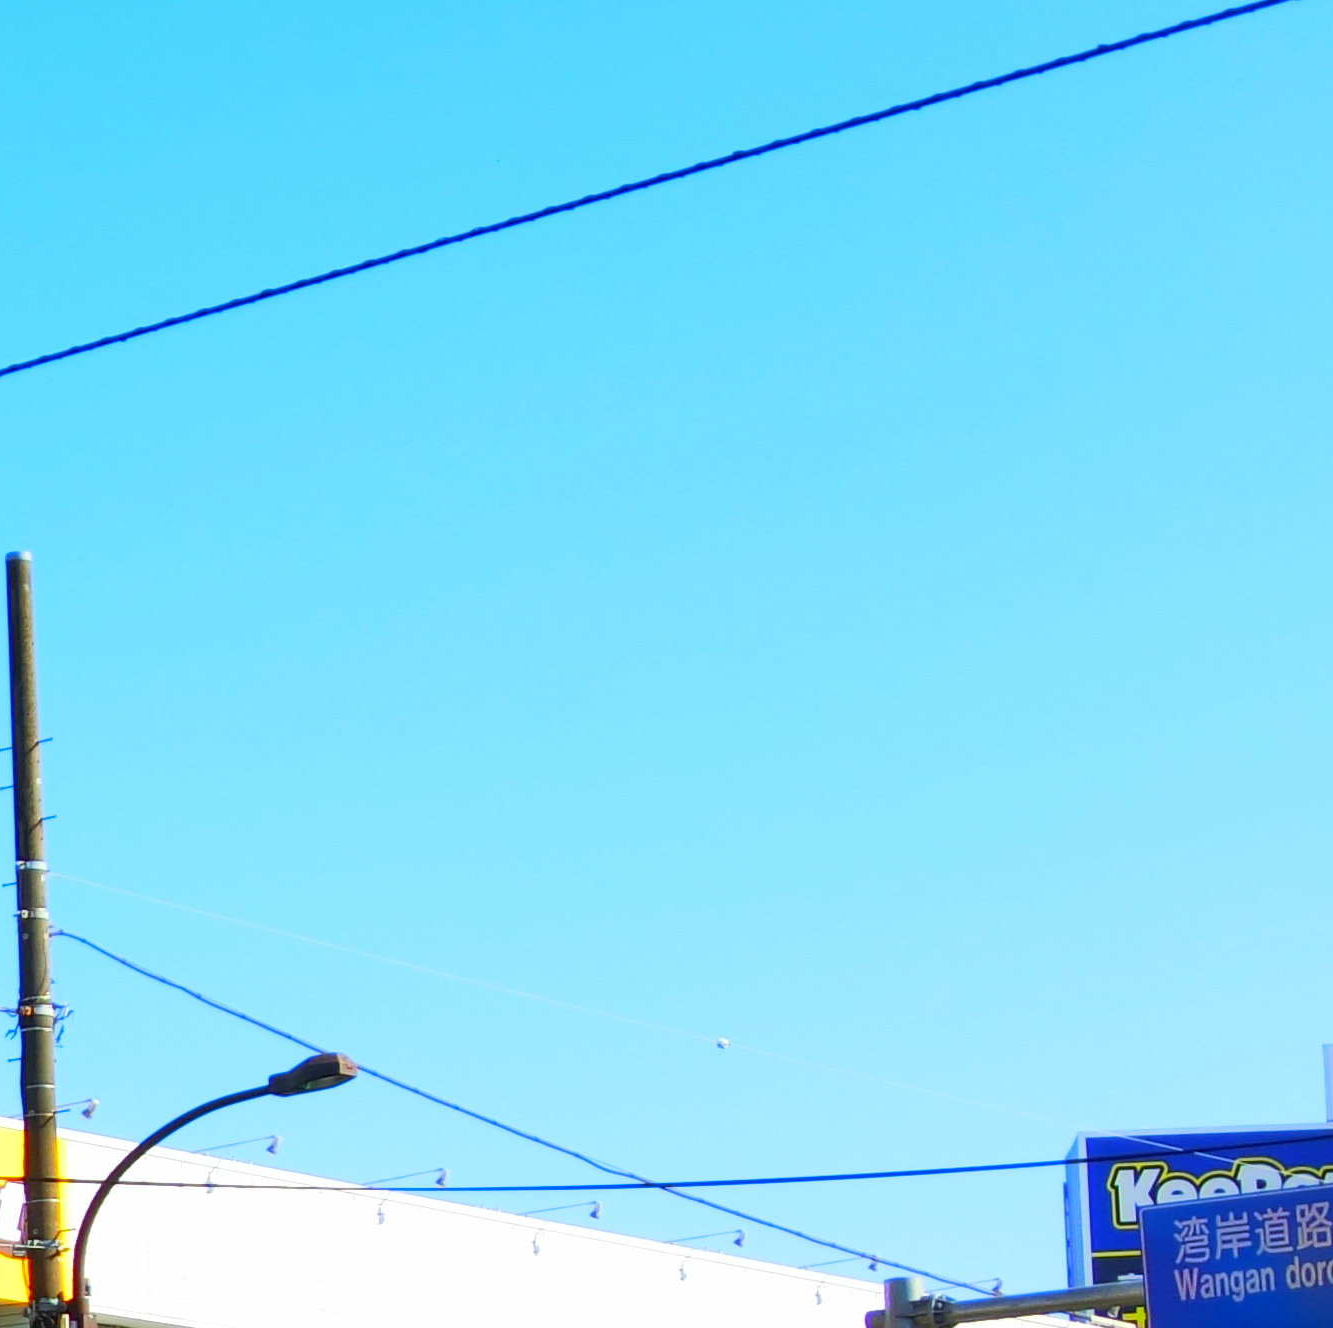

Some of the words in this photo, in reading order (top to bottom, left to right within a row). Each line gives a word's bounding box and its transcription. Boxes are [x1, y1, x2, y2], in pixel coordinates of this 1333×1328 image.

[1173, 1201, 1333, 1265] 湾岸道路
[1174, 1266, 1276, 1302] Wangan
